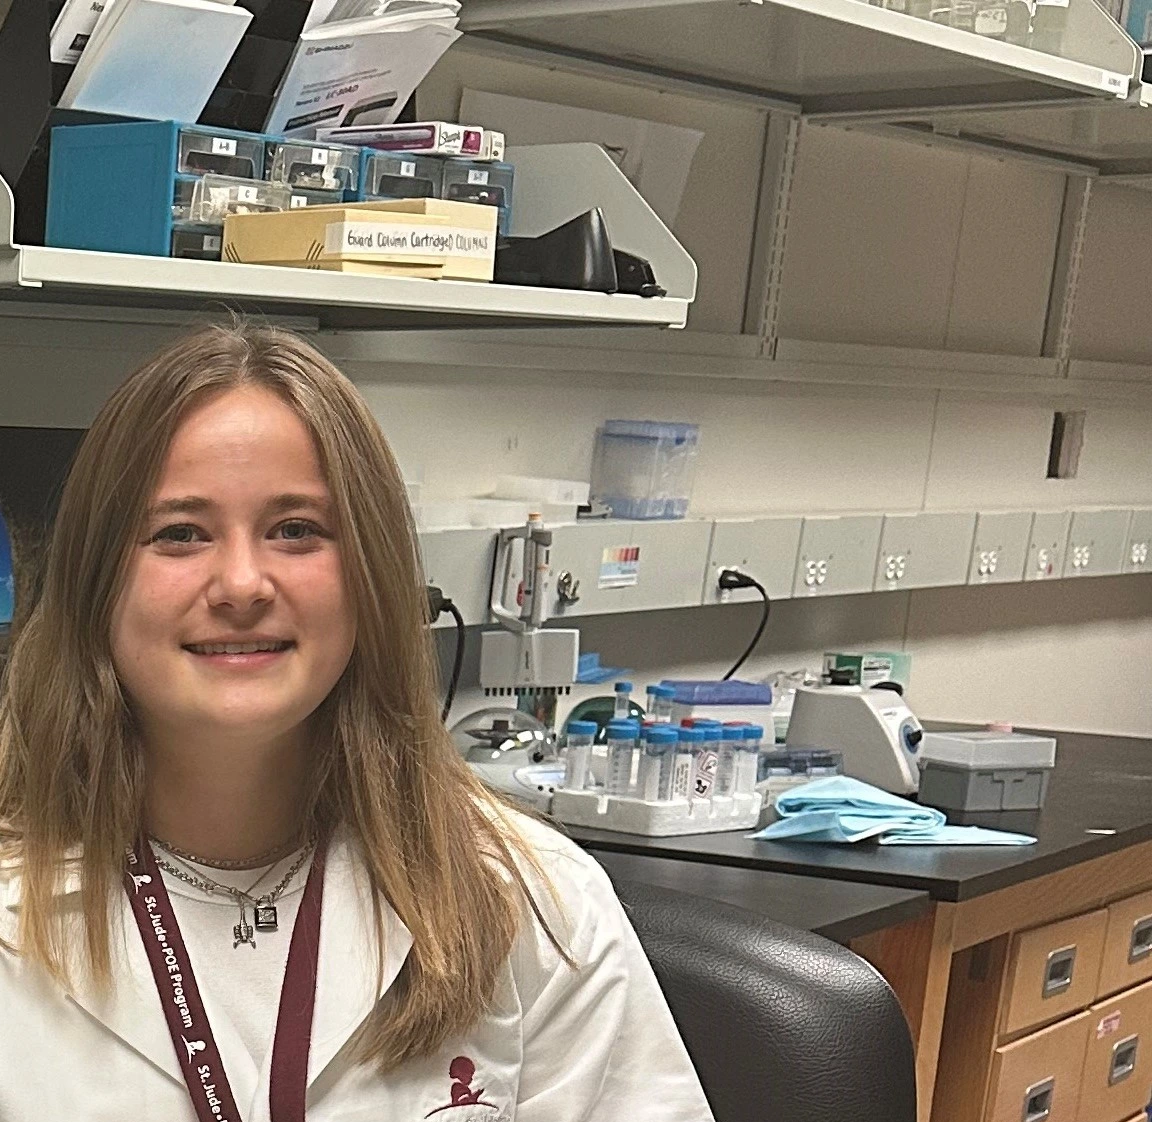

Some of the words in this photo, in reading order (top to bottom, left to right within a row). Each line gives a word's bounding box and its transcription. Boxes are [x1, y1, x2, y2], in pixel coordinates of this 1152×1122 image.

[348, 230, 373, 247] Guard
[377, 232, 408, 248] Column
[144, 895, 157, 914] St.
[170, 973, 194, 1029] Program
[198, 1064, 211, 1083] St.
